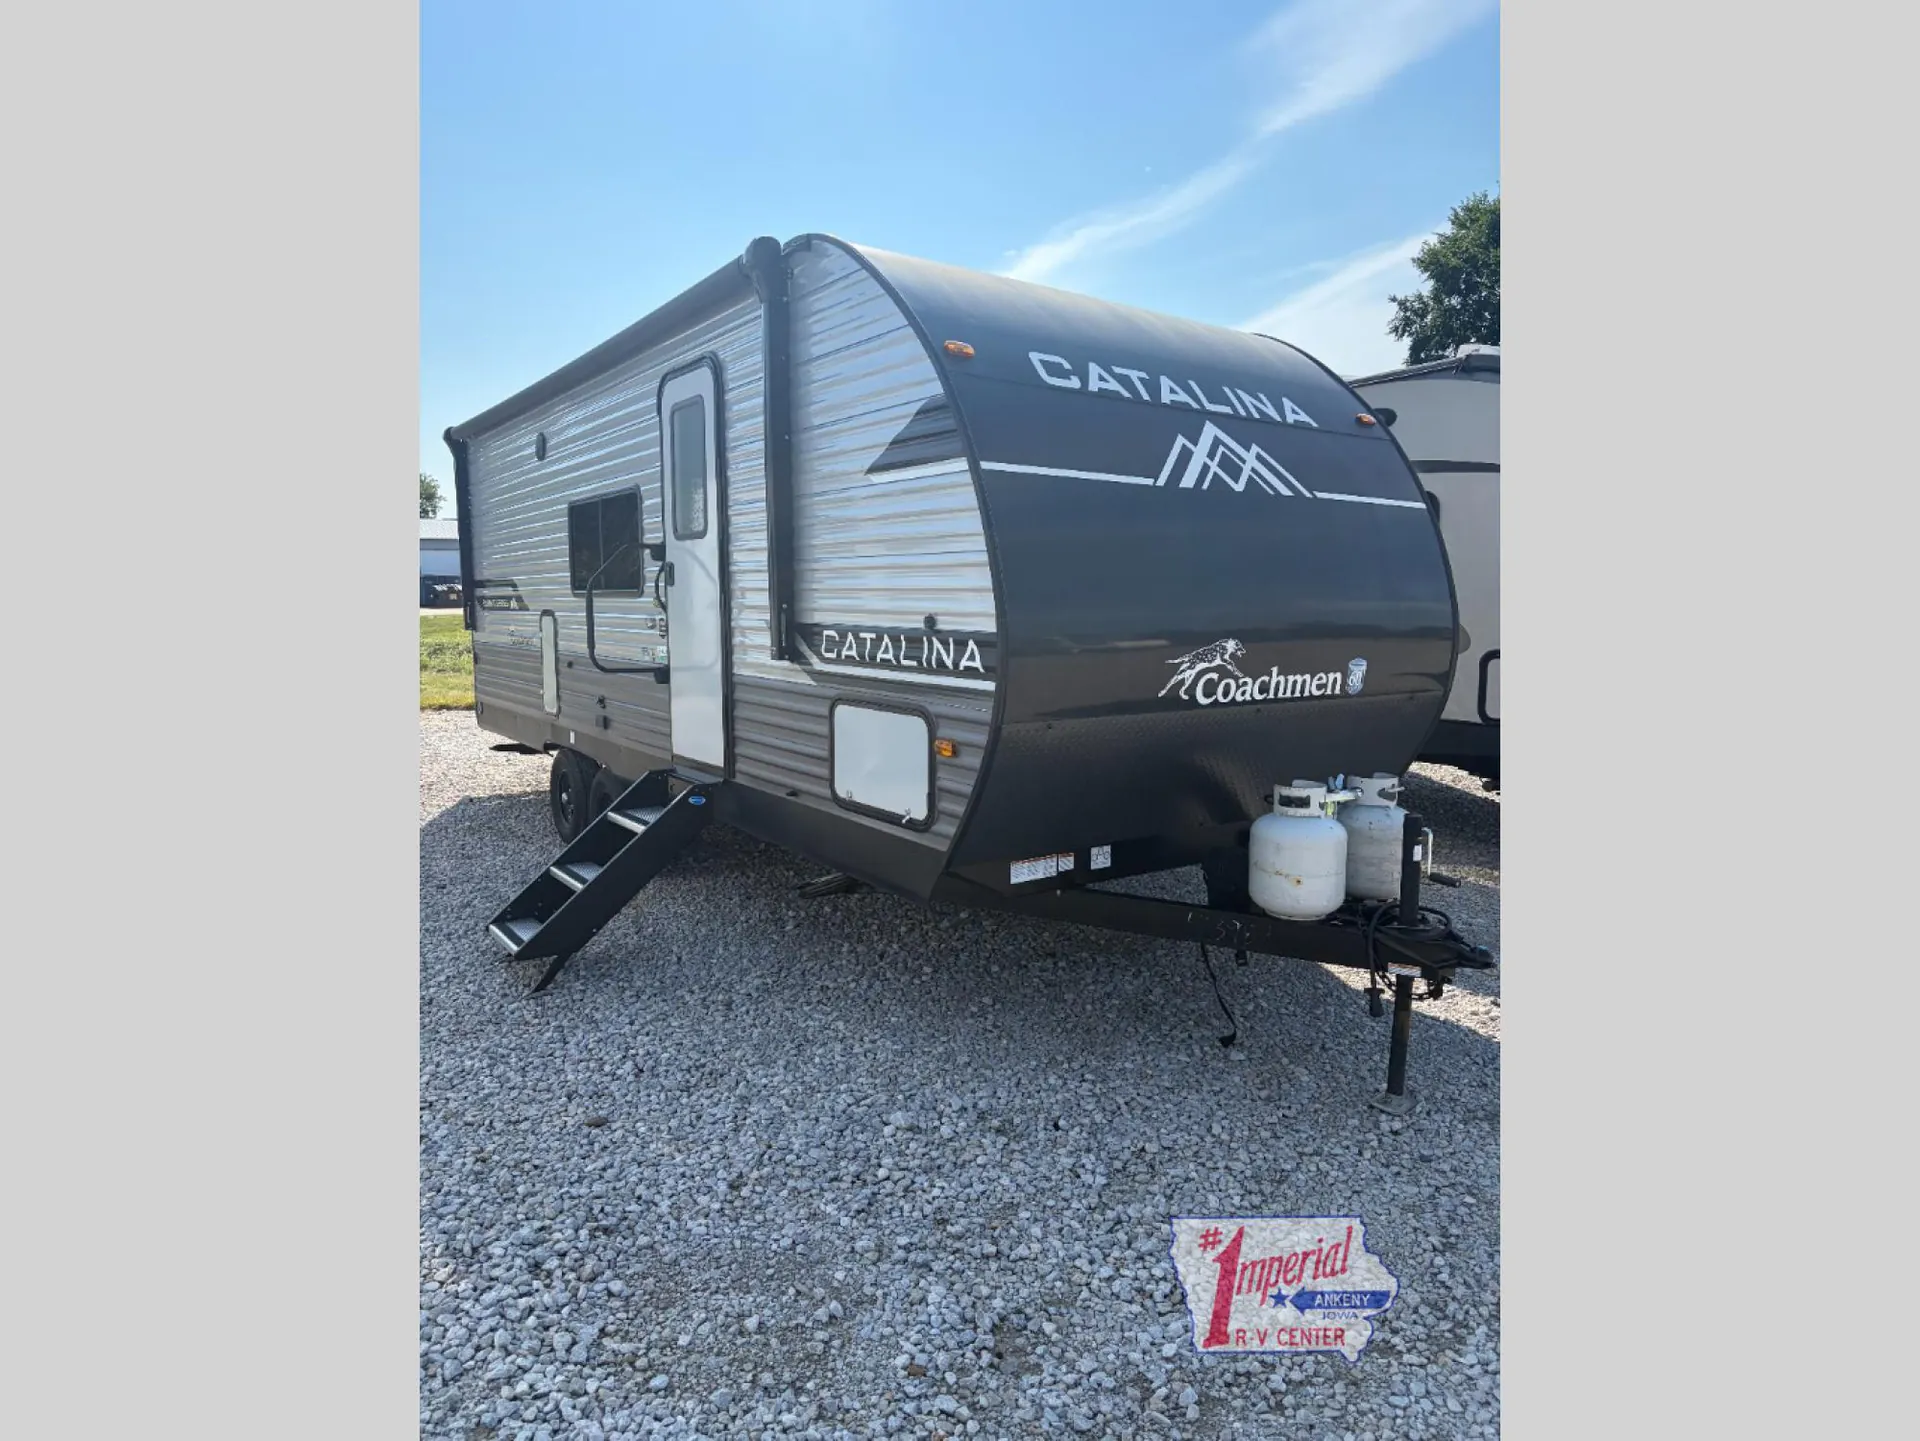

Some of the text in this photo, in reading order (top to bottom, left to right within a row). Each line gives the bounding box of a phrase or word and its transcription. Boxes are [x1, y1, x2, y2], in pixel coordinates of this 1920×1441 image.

[1028, 351, 1319, 428] CATALINA
[821, 629, 985, 673] CATALINA
[1195, 665, 1342, 705] Coachmen
